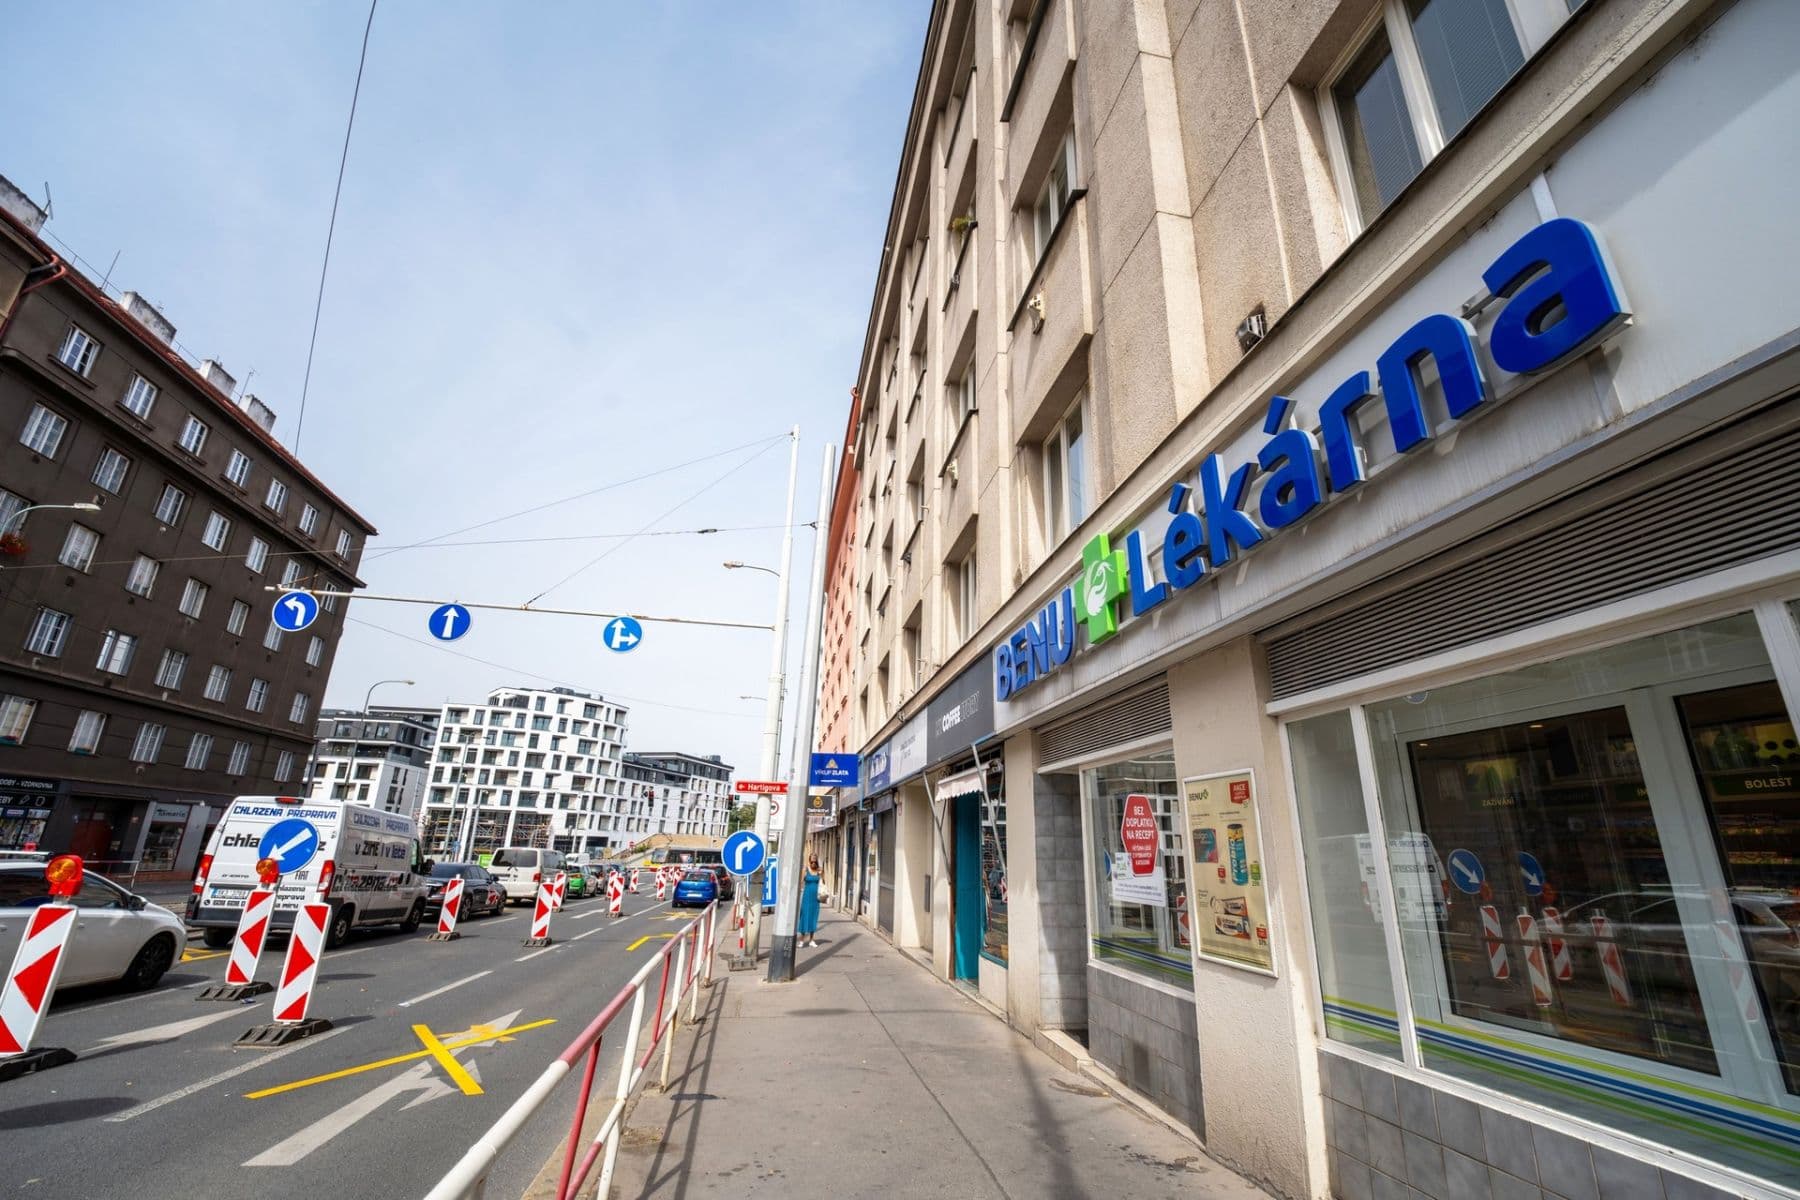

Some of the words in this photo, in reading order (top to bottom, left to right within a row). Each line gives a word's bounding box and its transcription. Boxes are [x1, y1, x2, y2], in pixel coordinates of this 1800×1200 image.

[996, 588, 1076, 702] BENU
[1127, 217, 1632, 617] Lékárna
[942, 704, 961, 733] COFFEE
[747, 783, 781, 793] Hartigova
[1744, 776, 1793, 790] BOLEST
[1188, 792, 1203, 802] BENU
[1133, 805, 1145, 816] BEZ
[1126, 817, 1154, 828] DOPLATKU
[1126, 829, 1135, 839] NA
[1135, 830, 1154, 840] RECEPT
[294, 870, 309, 881] FIAT
